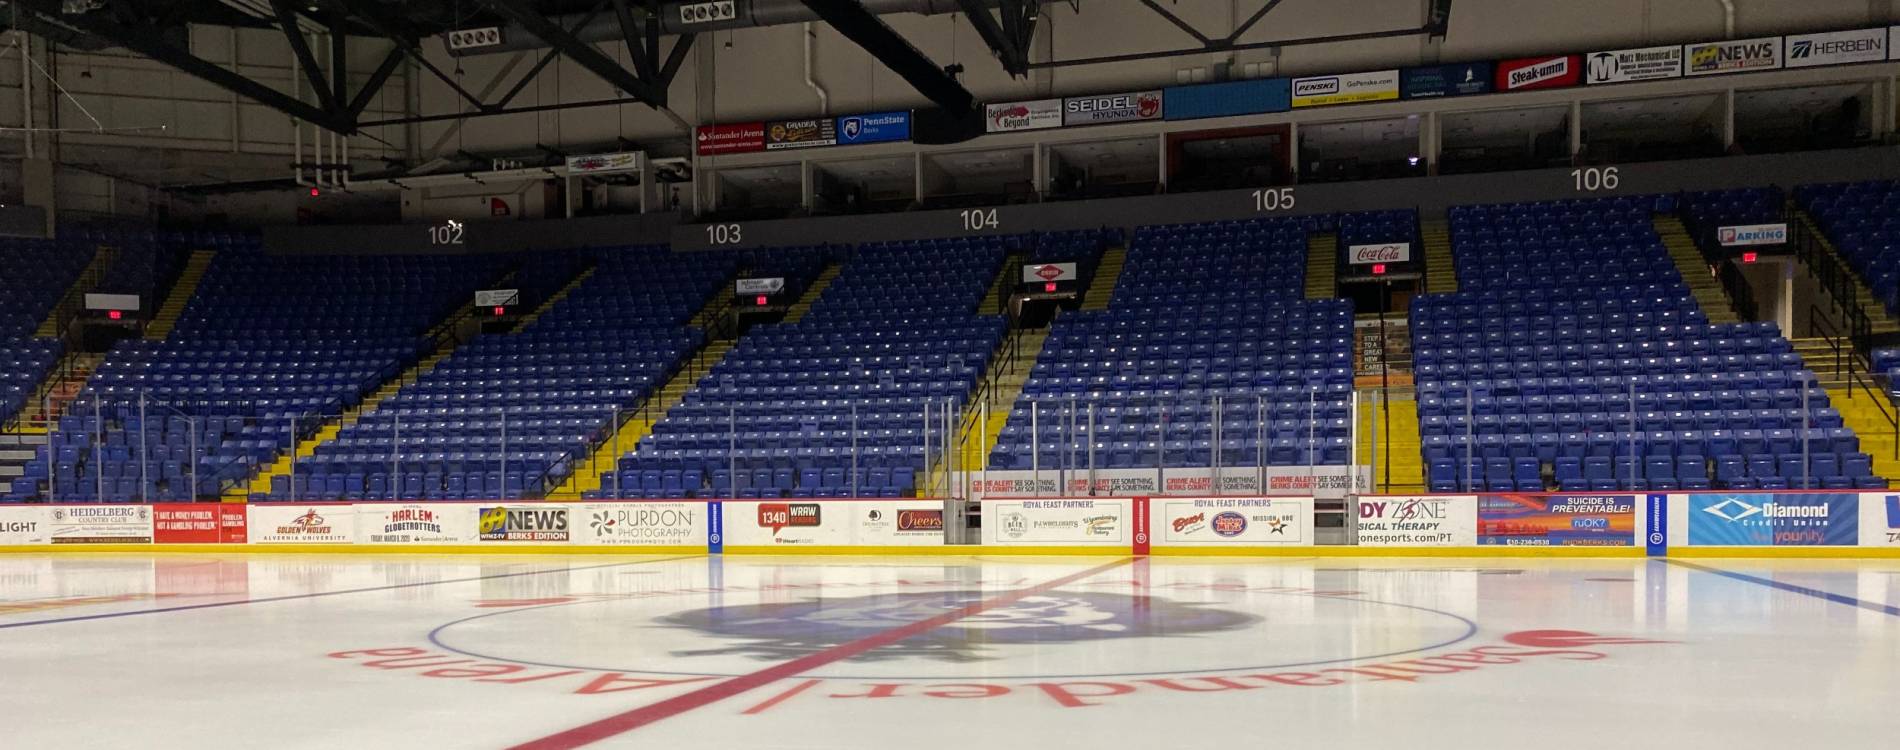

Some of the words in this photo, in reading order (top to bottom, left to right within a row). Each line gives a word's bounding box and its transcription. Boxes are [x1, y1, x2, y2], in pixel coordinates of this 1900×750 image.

[1718, 43, 1773, 61] NEWS
[1814, 38, 1881, 55] HERBEIN
[1511, 62, 1565, 85] Steak-umm
[1297, 82, 1337, 92] PENSKE
[1346, 79, 1393, 88] GoPenske.com
[1067, 96, 1137, 113] SEIDEL
[863, 116, 905, 126] PennState
[1003, 116, 1030, 128] Beyond
[707, 130, 741, 141] Santander
[743, 129, 765, 138] Arena
[1571, 166, 1619, 191] 106
[1252, 187, 1295, 210] 105
[961, 208, 999, 231] 104
[428, 226, 463, 244] 102
[706, 224, 742, 245] 103
[1720, 229, 1784, 243] PARKING
[1023, 500, 1042, 508] ROYAL
[1043, 500, 1061, 508] FEAST
[1063, 500, 1094, 508] PARTNERS
[1194, 499, 1214, 508] ROYAL
[1216, 499, 1235, 508] FEAST
[1237, 499, 1271, 508] PARTNERS
[1567, 497, 1603, 505] SUICIDE
[70, 507, 135, 517] HEIDELBERG
[790, 506, 817, 517] WRAW
[1360, 502, 1387, 518] DY
[1391, 500, 1448, 519] ZONE
[1552, 504, 1631, 513] PREVENTABLE!
[1762, 502, 1829, 517] Diamond
[392, 508, 433, 523] HARLEM
[480, 507, 506, 533] 69
[507, 510, 568, 531] NEWS
[618, 510, 692, 527] PURDON
[762, 511, 786, 524] 1340
[898, 511, 942, 529] Cheers
[0, 522, 37, 533] LIGHT
[384, 522, 441, 534] GLOBETROTTERS
[1391, 522, 1440, 531] THERAPY
[1573, 518, 1606, 528] ruOK?
[276, 526, 300, 534] GOLDEN
[306, 526, 332, 534] WOLVES
[618, 528, 693, 538] PHOTOGRAPHY
